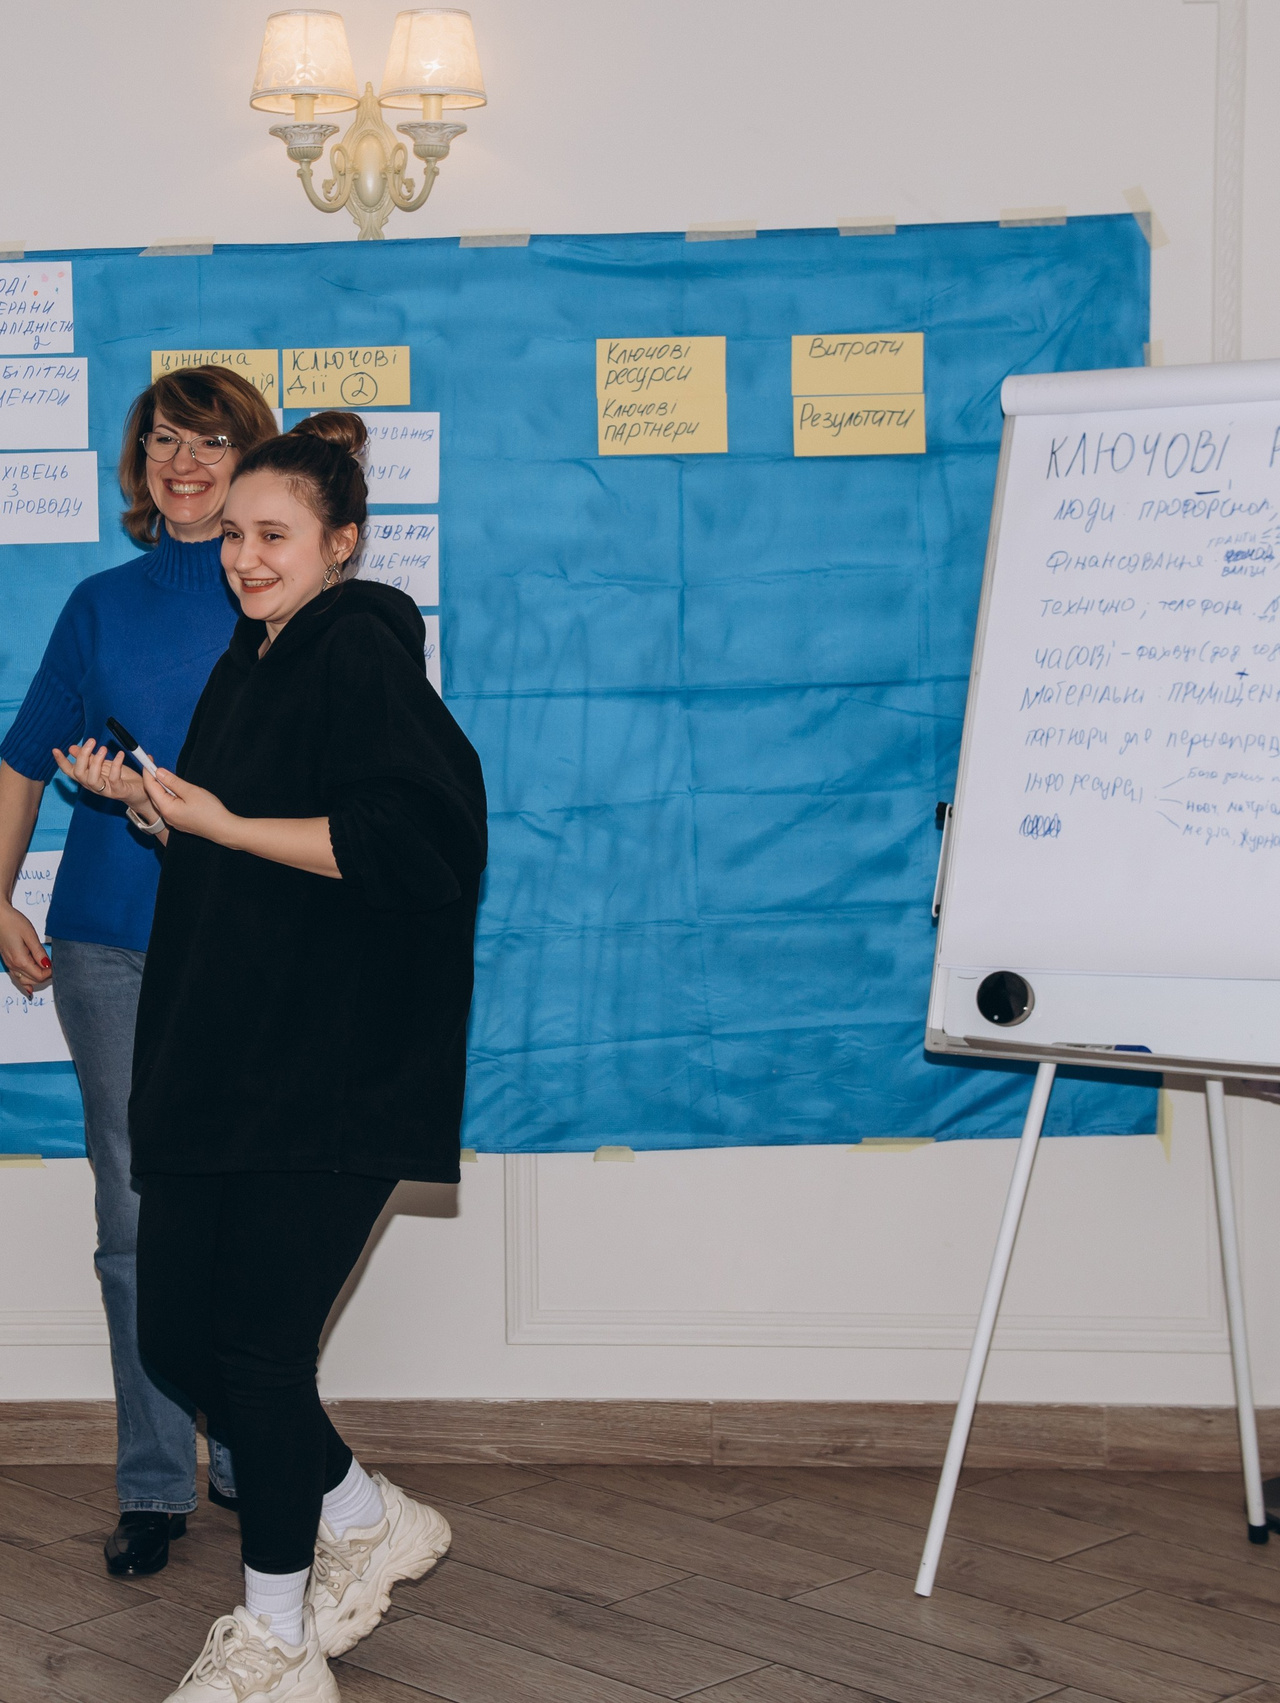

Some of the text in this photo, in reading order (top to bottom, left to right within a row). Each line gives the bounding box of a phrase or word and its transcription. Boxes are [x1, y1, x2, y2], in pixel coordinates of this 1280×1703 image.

[808, 337, 905, 362] Витрати
[604, 365, 693, 393] ресурси
[799, 402, 916, 437] Результати
[1046, 423, 1233, 480] КЛЮЧОВІ
